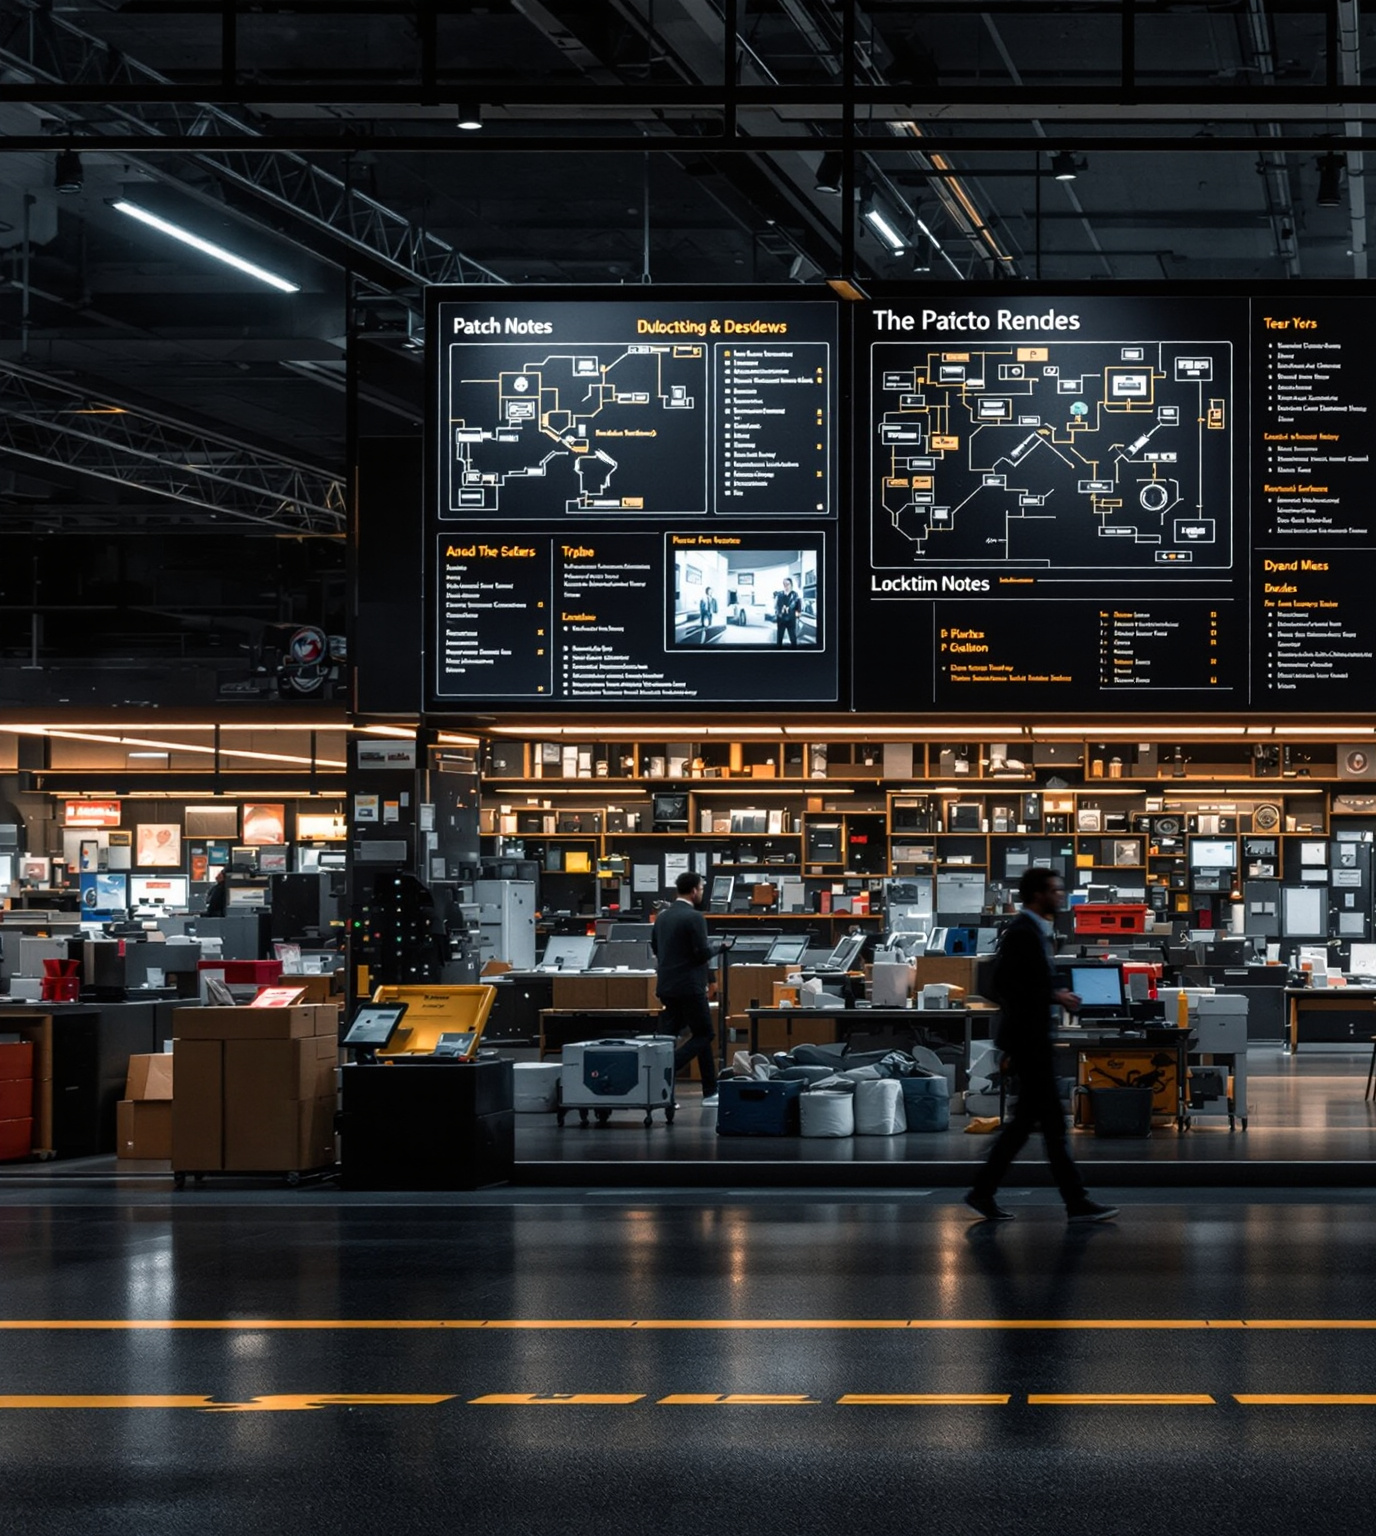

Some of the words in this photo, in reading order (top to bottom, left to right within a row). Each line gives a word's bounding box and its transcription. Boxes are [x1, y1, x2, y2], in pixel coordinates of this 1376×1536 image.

[454, 317, 500, 334] Patch
[505, 318, 552, 334] Notes
[710, 320, 720, 333] &
[873, 309, 914, 330] The
[923, 310, 990, 330] Paicto
[998, 309, 1080, 330] Rendes
[942, 576, 990, 591] Notes
